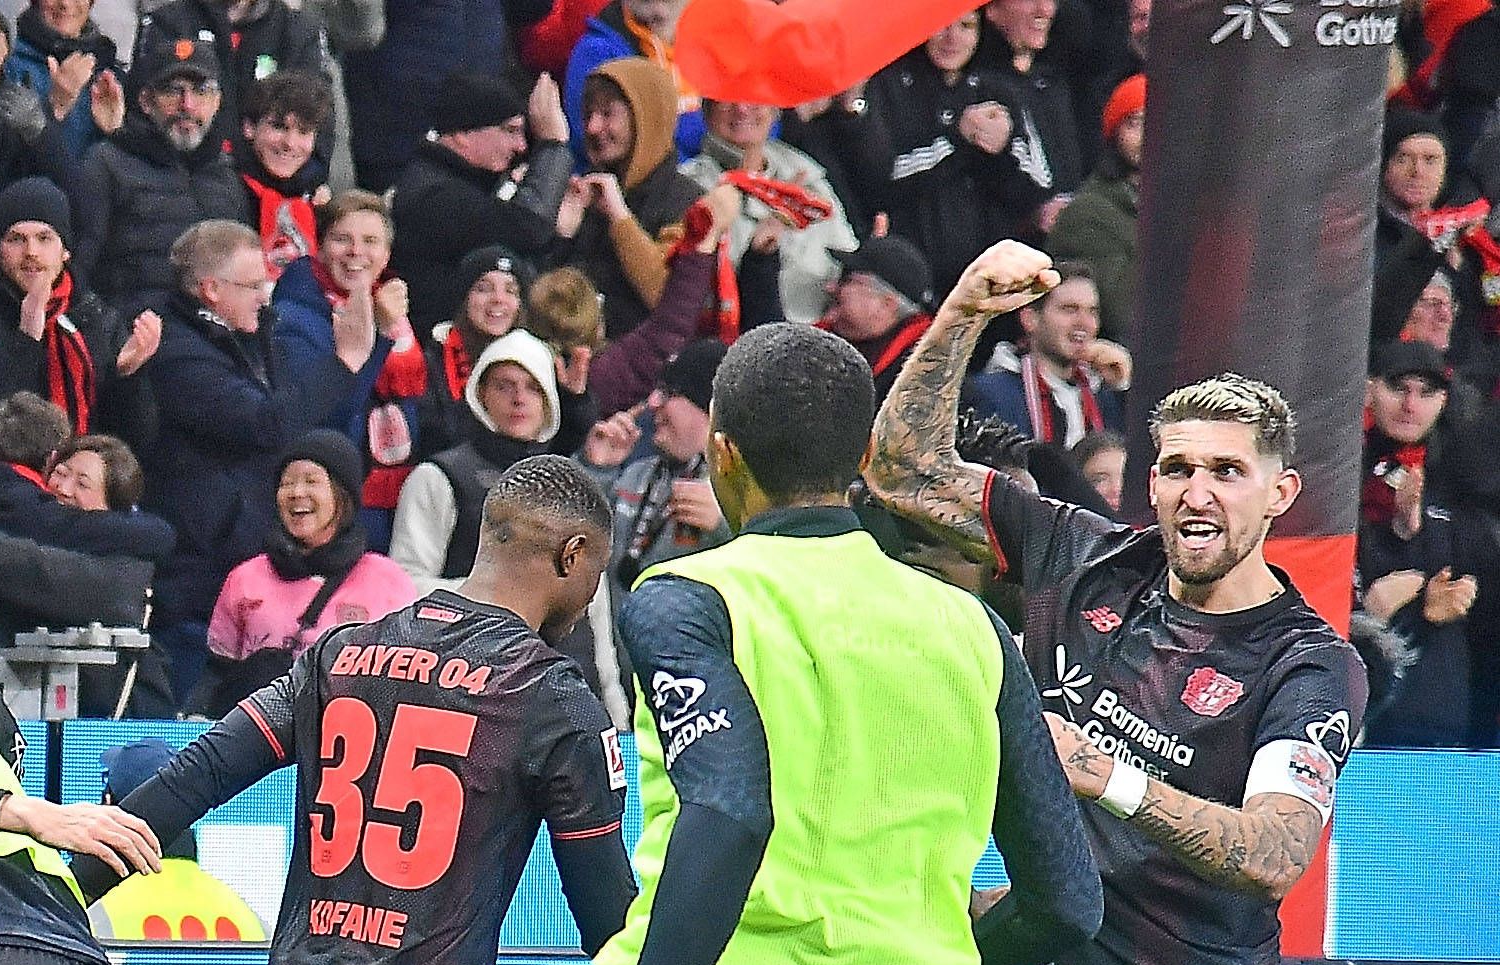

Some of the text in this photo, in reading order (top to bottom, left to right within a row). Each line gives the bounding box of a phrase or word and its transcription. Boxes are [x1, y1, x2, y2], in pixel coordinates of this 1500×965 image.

[330, 645, 493, 696] BAYER 04
[1091, 688, 1196, 767] Barmenia
[308, 696, 479, 890] 35
